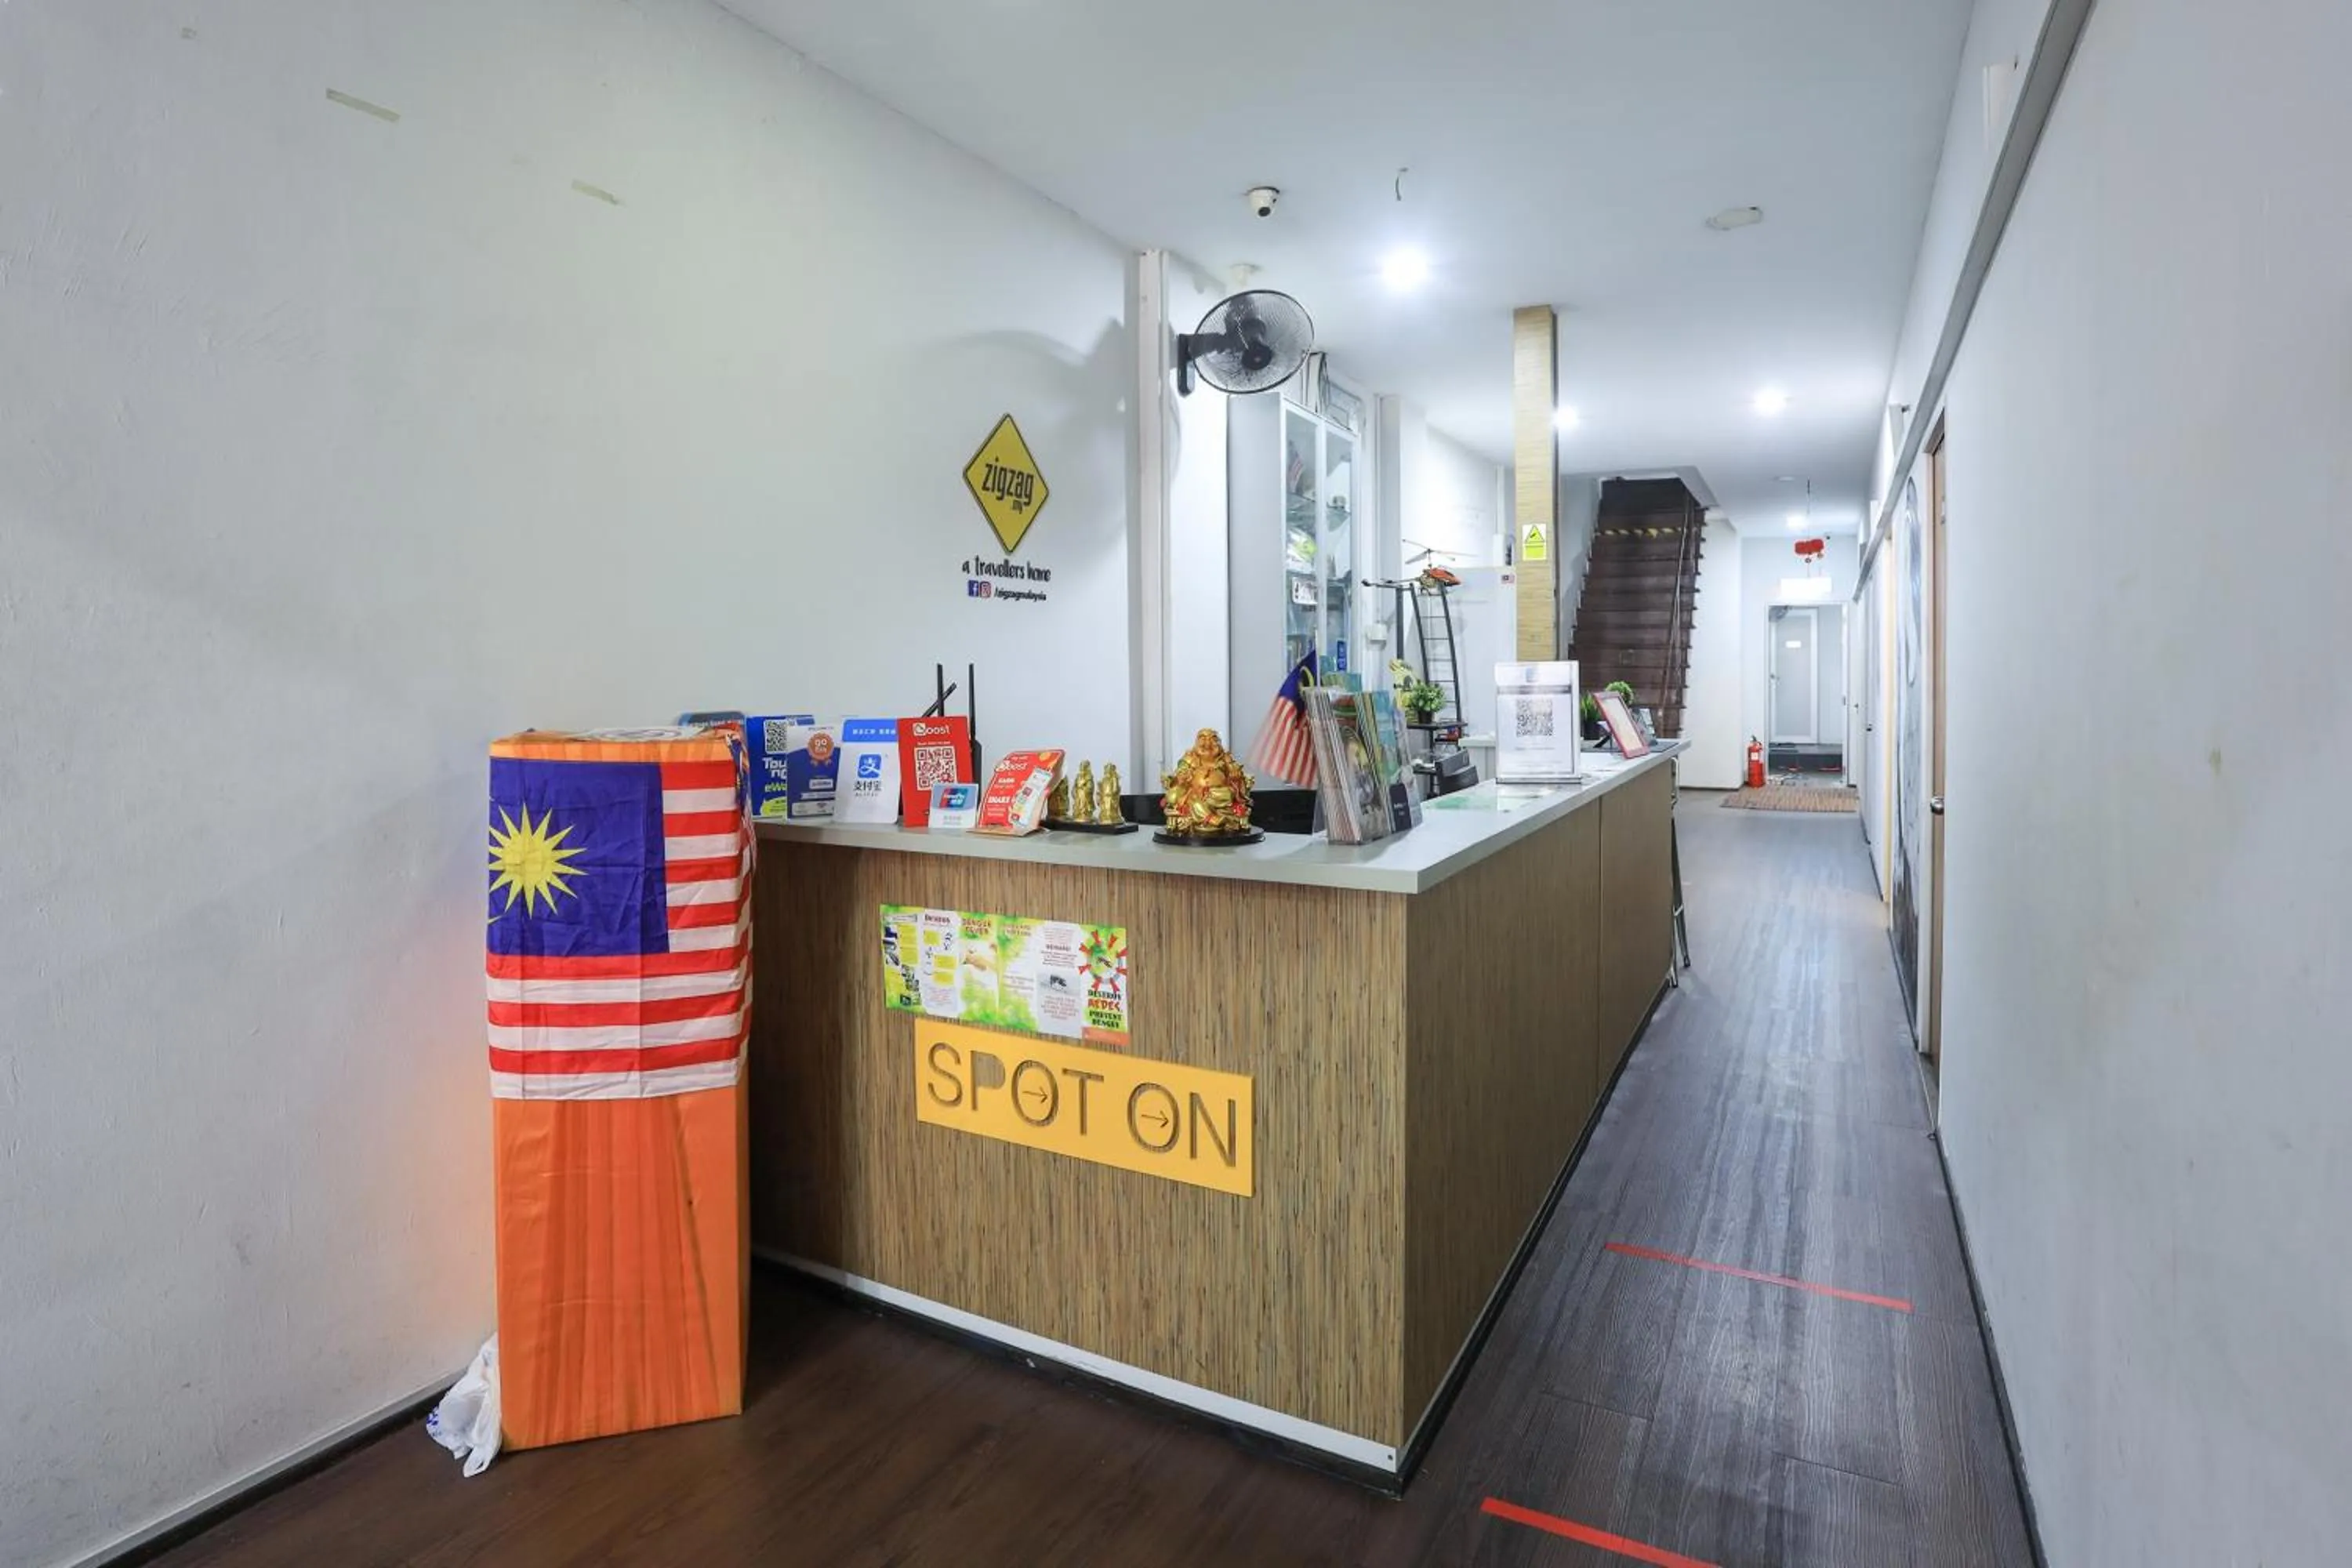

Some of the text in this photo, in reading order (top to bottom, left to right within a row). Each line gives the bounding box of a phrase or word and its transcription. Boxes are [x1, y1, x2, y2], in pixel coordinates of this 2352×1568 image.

[981, 456, 1034, 507] zigzag
[962, 561, 970, 574] a
[927, 1042, 1236, 1167] SPOT ON
